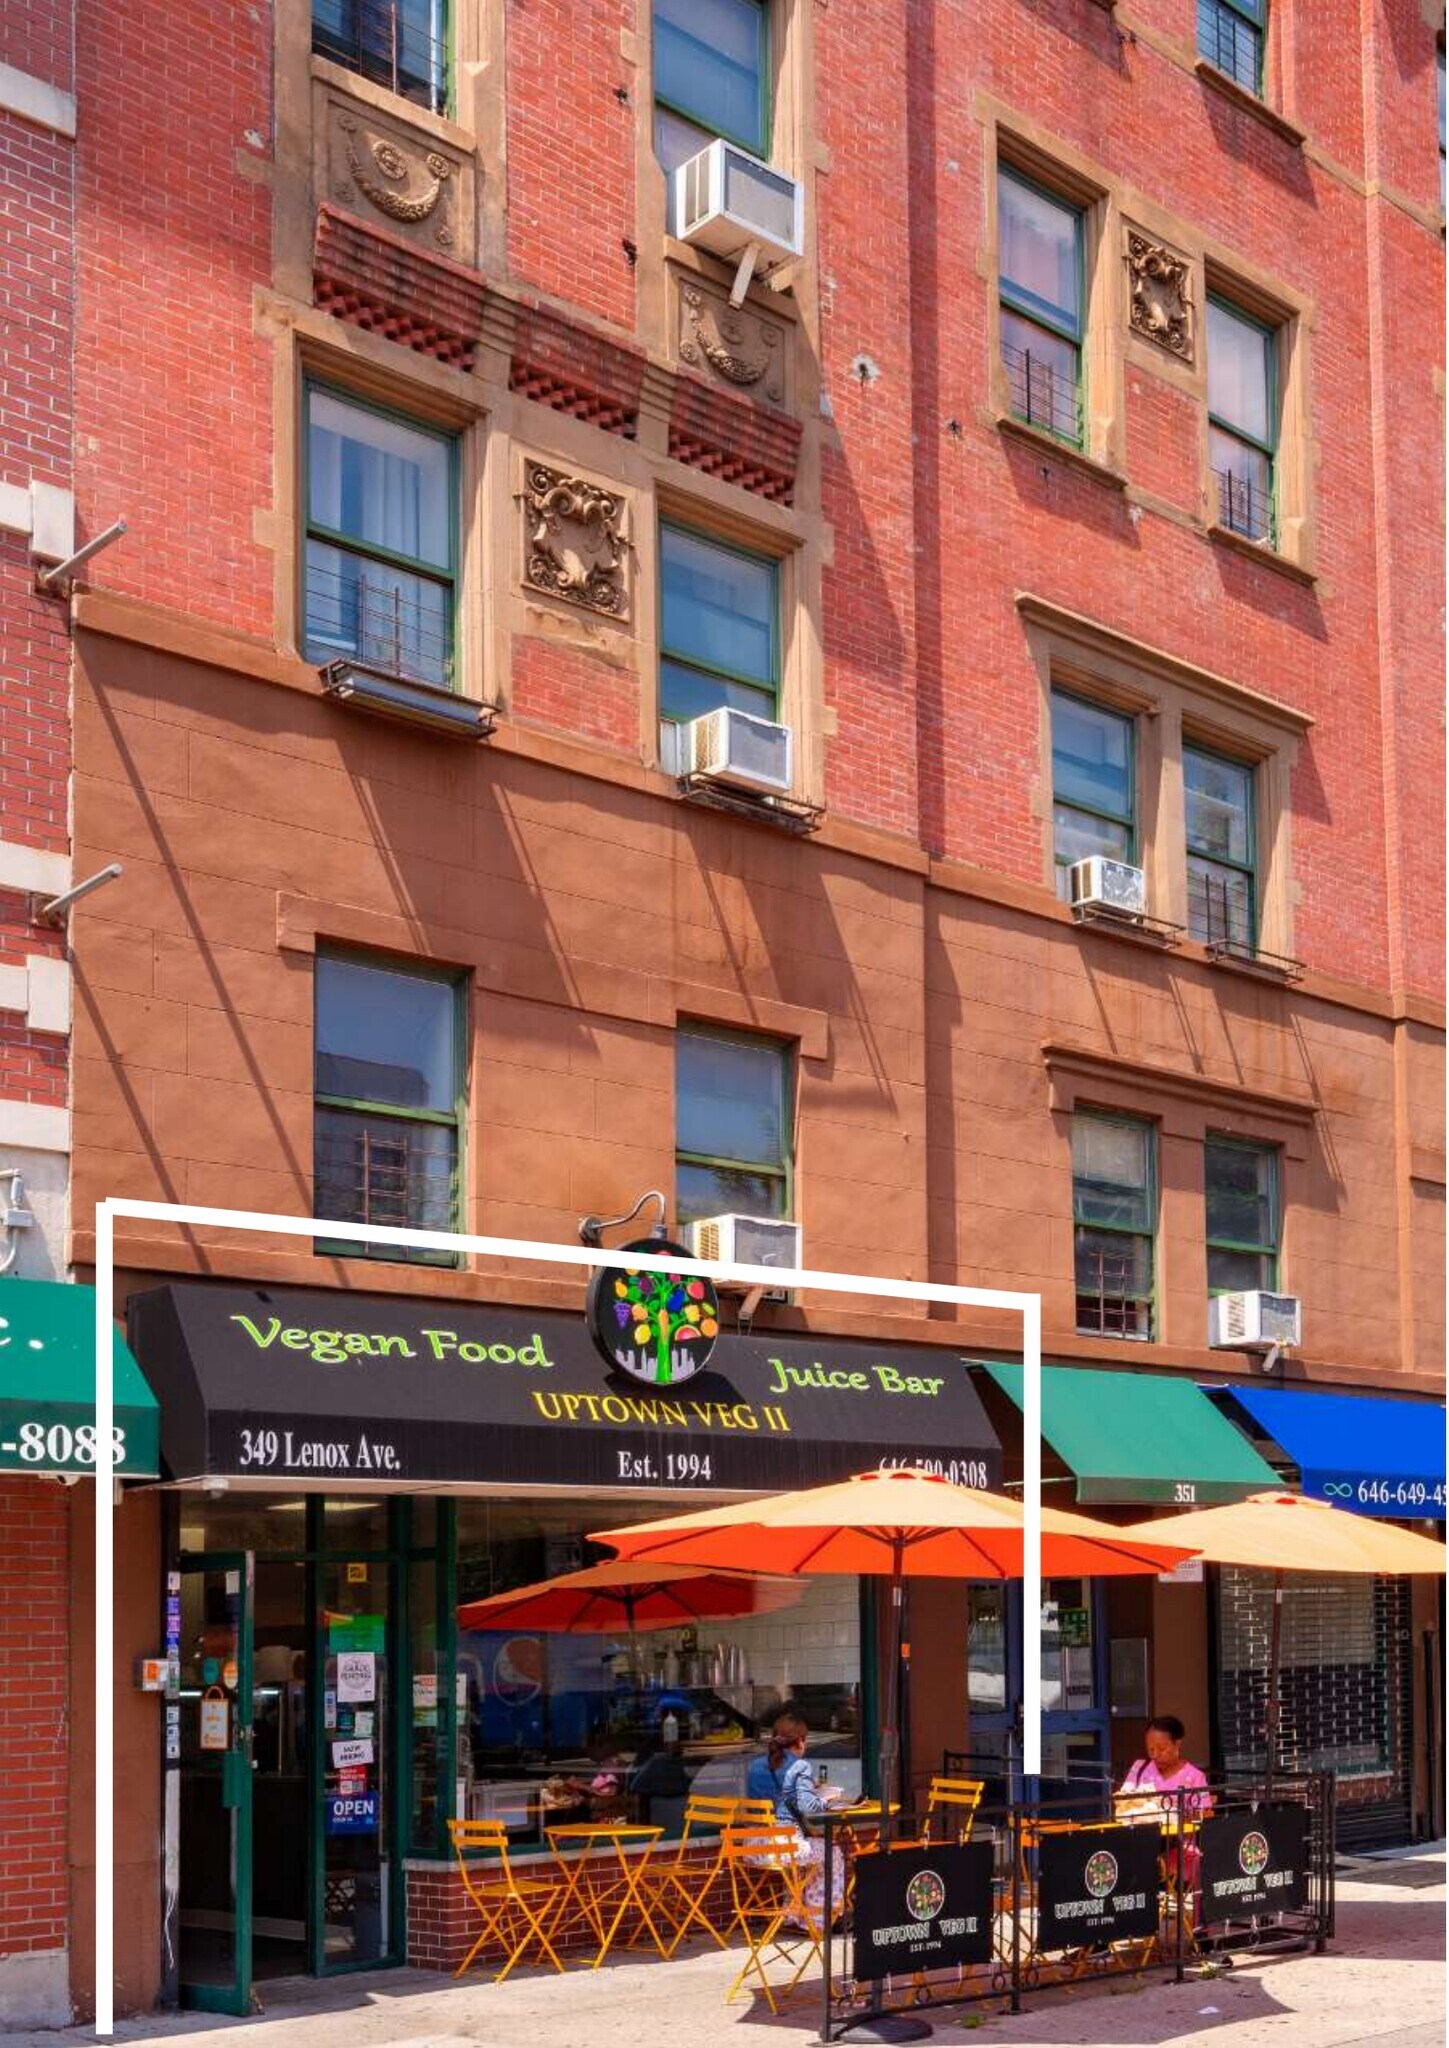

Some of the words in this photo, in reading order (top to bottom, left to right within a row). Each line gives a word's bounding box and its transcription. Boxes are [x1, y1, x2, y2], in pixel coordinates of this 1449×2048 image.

[229, 1315, 417, 1364] Vegan
[421, 1329, 554, 1367] Food
[768, 1358, 870, 1393] Juice
[872, 1365, 944, 1395] Bar
[532, 1391, 689, 1427] UPTOWN
[691, 1402, 759, 1430] VEG
[763, 1406, 792, 1432] II
[239, 1429, 279, 1467] 349
[284, 1431, 350, 1469] Lenox
[356, 1434, 401, 1470] Ave.
[617, 1450, 659, 1479] Est.
[666, 1453, 711, 1480] 1994
[1174, 1484, 1196, 1502] 351
[333, 1801, 374, 1816] OPEN
[872, 1922, 930, 1946] UPTOWN
[939, 1918, 966, 1936] VEG
